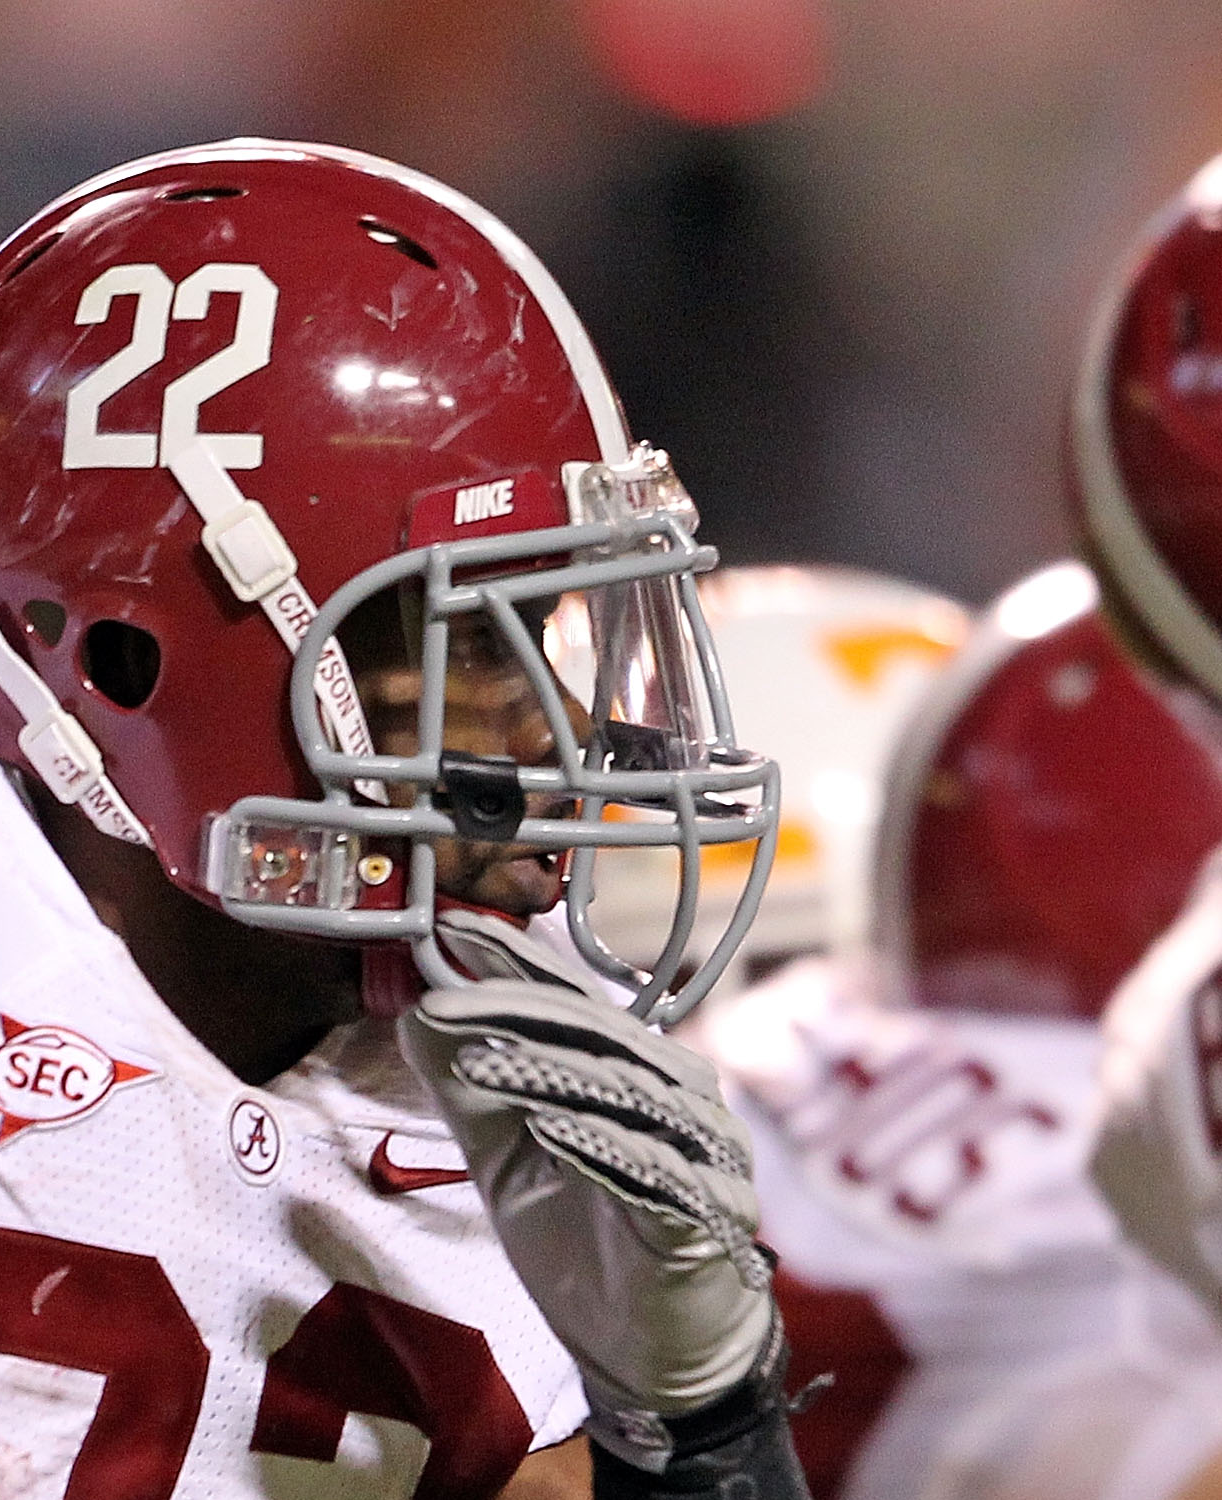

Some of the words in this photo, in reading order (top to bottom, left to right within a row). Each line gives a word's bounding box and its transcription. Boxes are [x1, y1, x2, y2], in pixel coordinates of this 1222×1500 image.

[62, 262, 279, 469] 22
[453, 478, 515, 526] NIKE
[277, 591, 356, 720] CRSON
[4, 1051, 90, 1102] SEC
